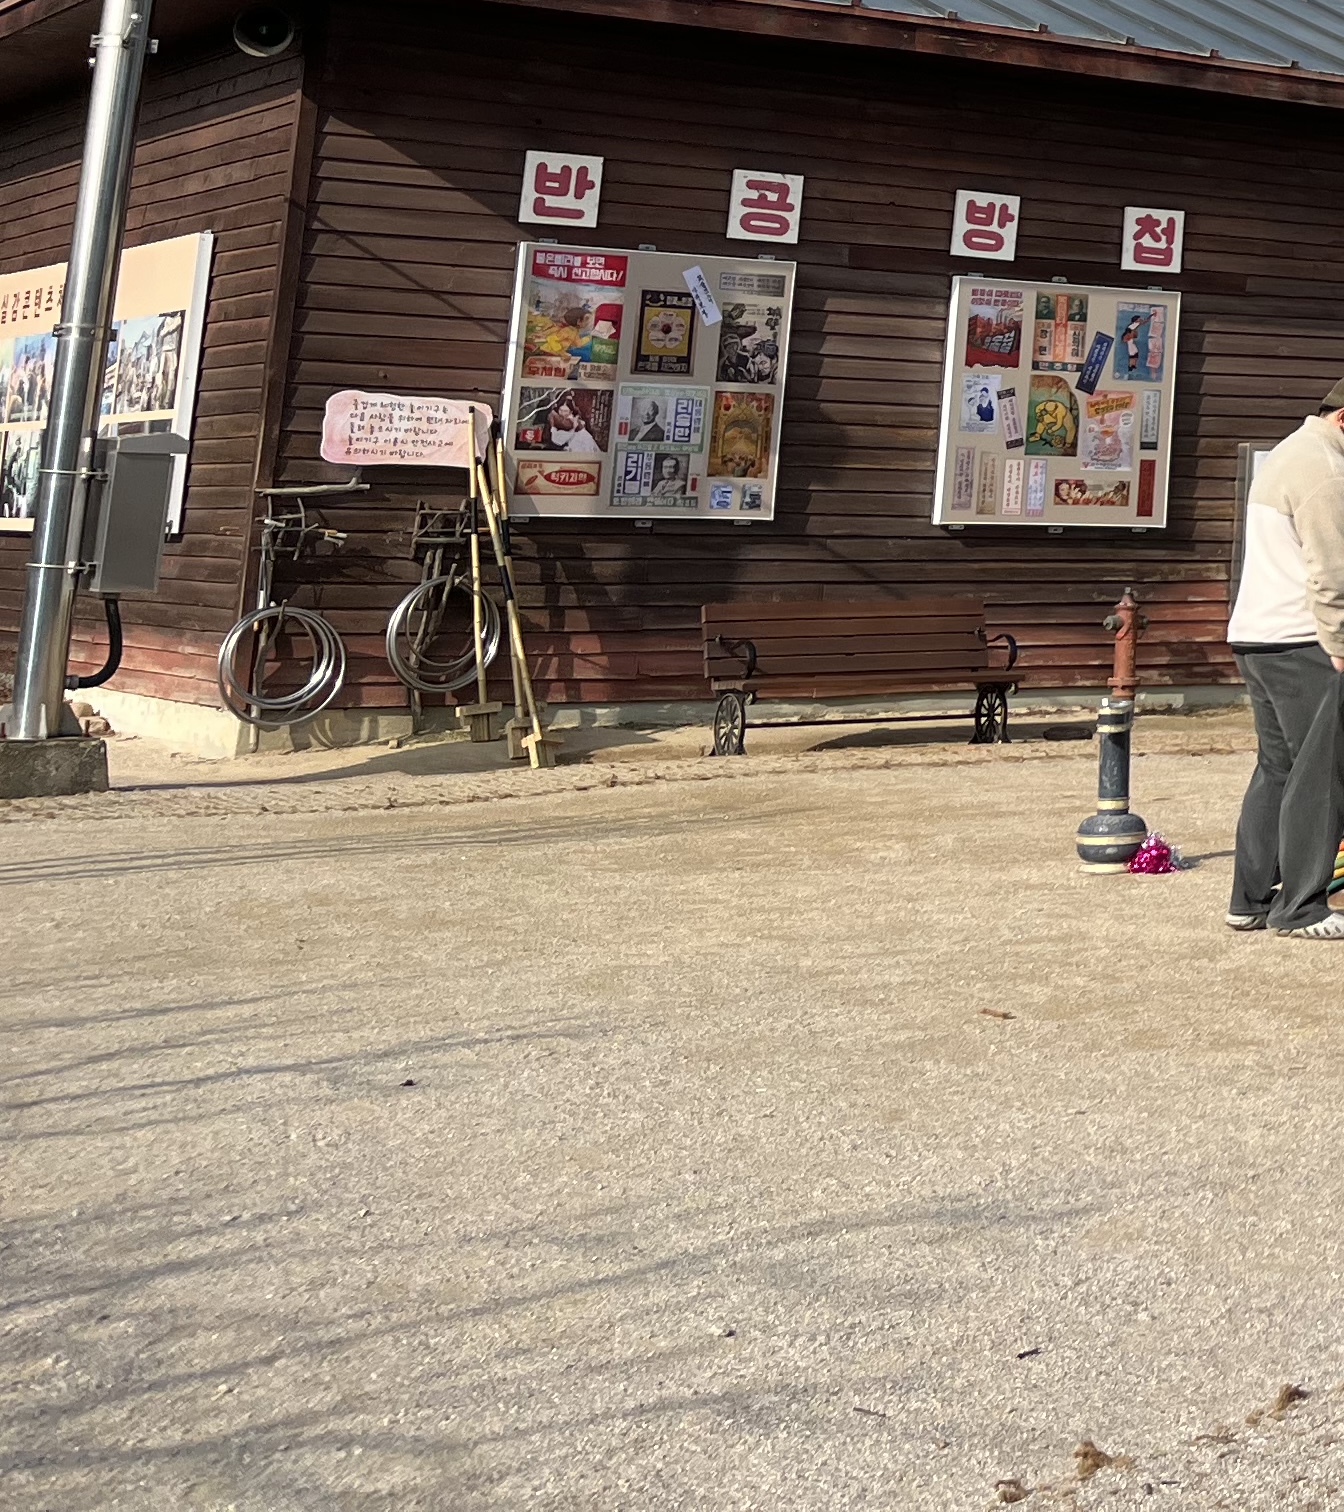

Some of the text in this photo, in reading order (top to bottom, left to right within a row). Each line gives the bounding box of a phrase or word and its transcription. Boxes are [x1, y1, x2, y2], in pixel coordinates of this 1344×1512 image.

[533, 162, 1175, 266] 반 공 방 첩
